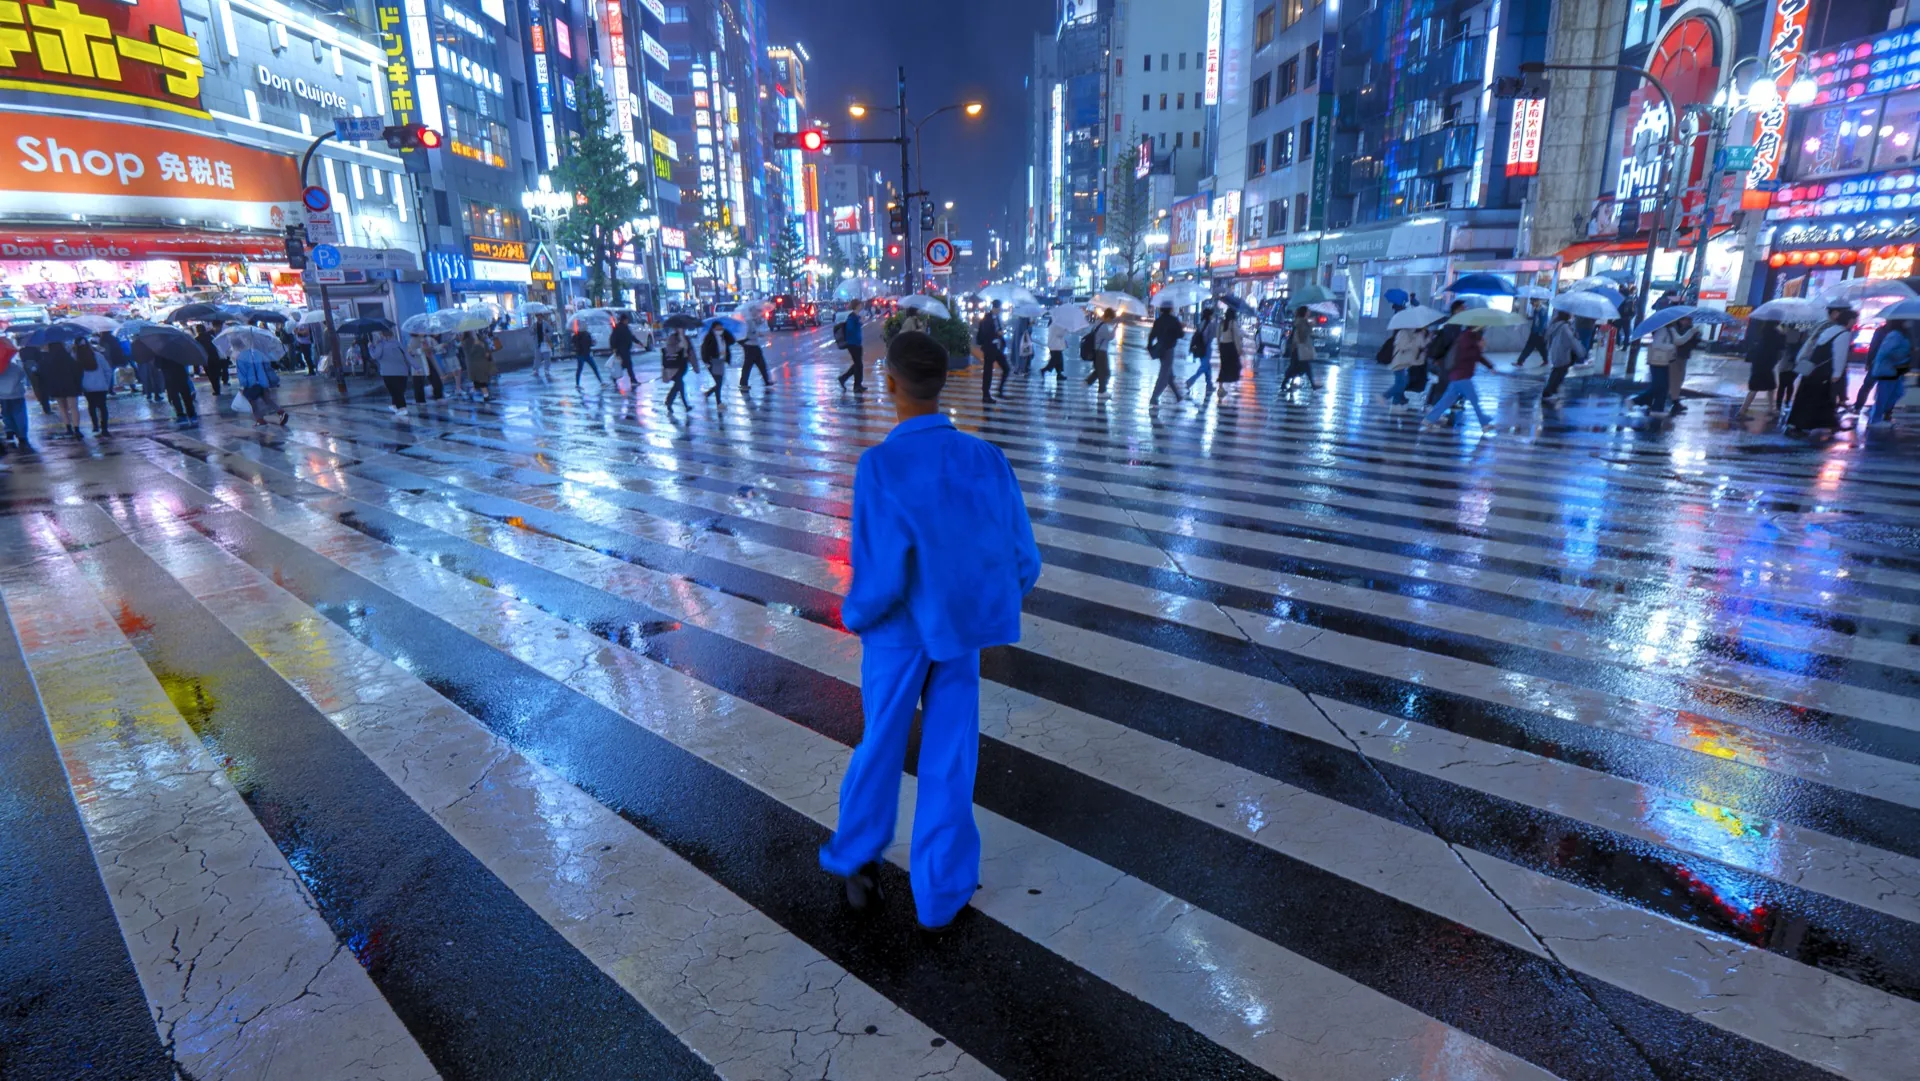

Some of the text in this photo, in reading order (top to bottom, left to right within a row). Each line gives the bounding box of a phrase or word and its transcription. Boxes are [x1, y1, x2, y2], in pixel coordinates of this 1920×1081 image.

[258, 64, 347, 109] Don Quijote
[379, 7, 414, 152] ドン・キホー
[16, 136, 235, 190] Shop 免税店
[2, 243, 130, 257] Don Quijote
